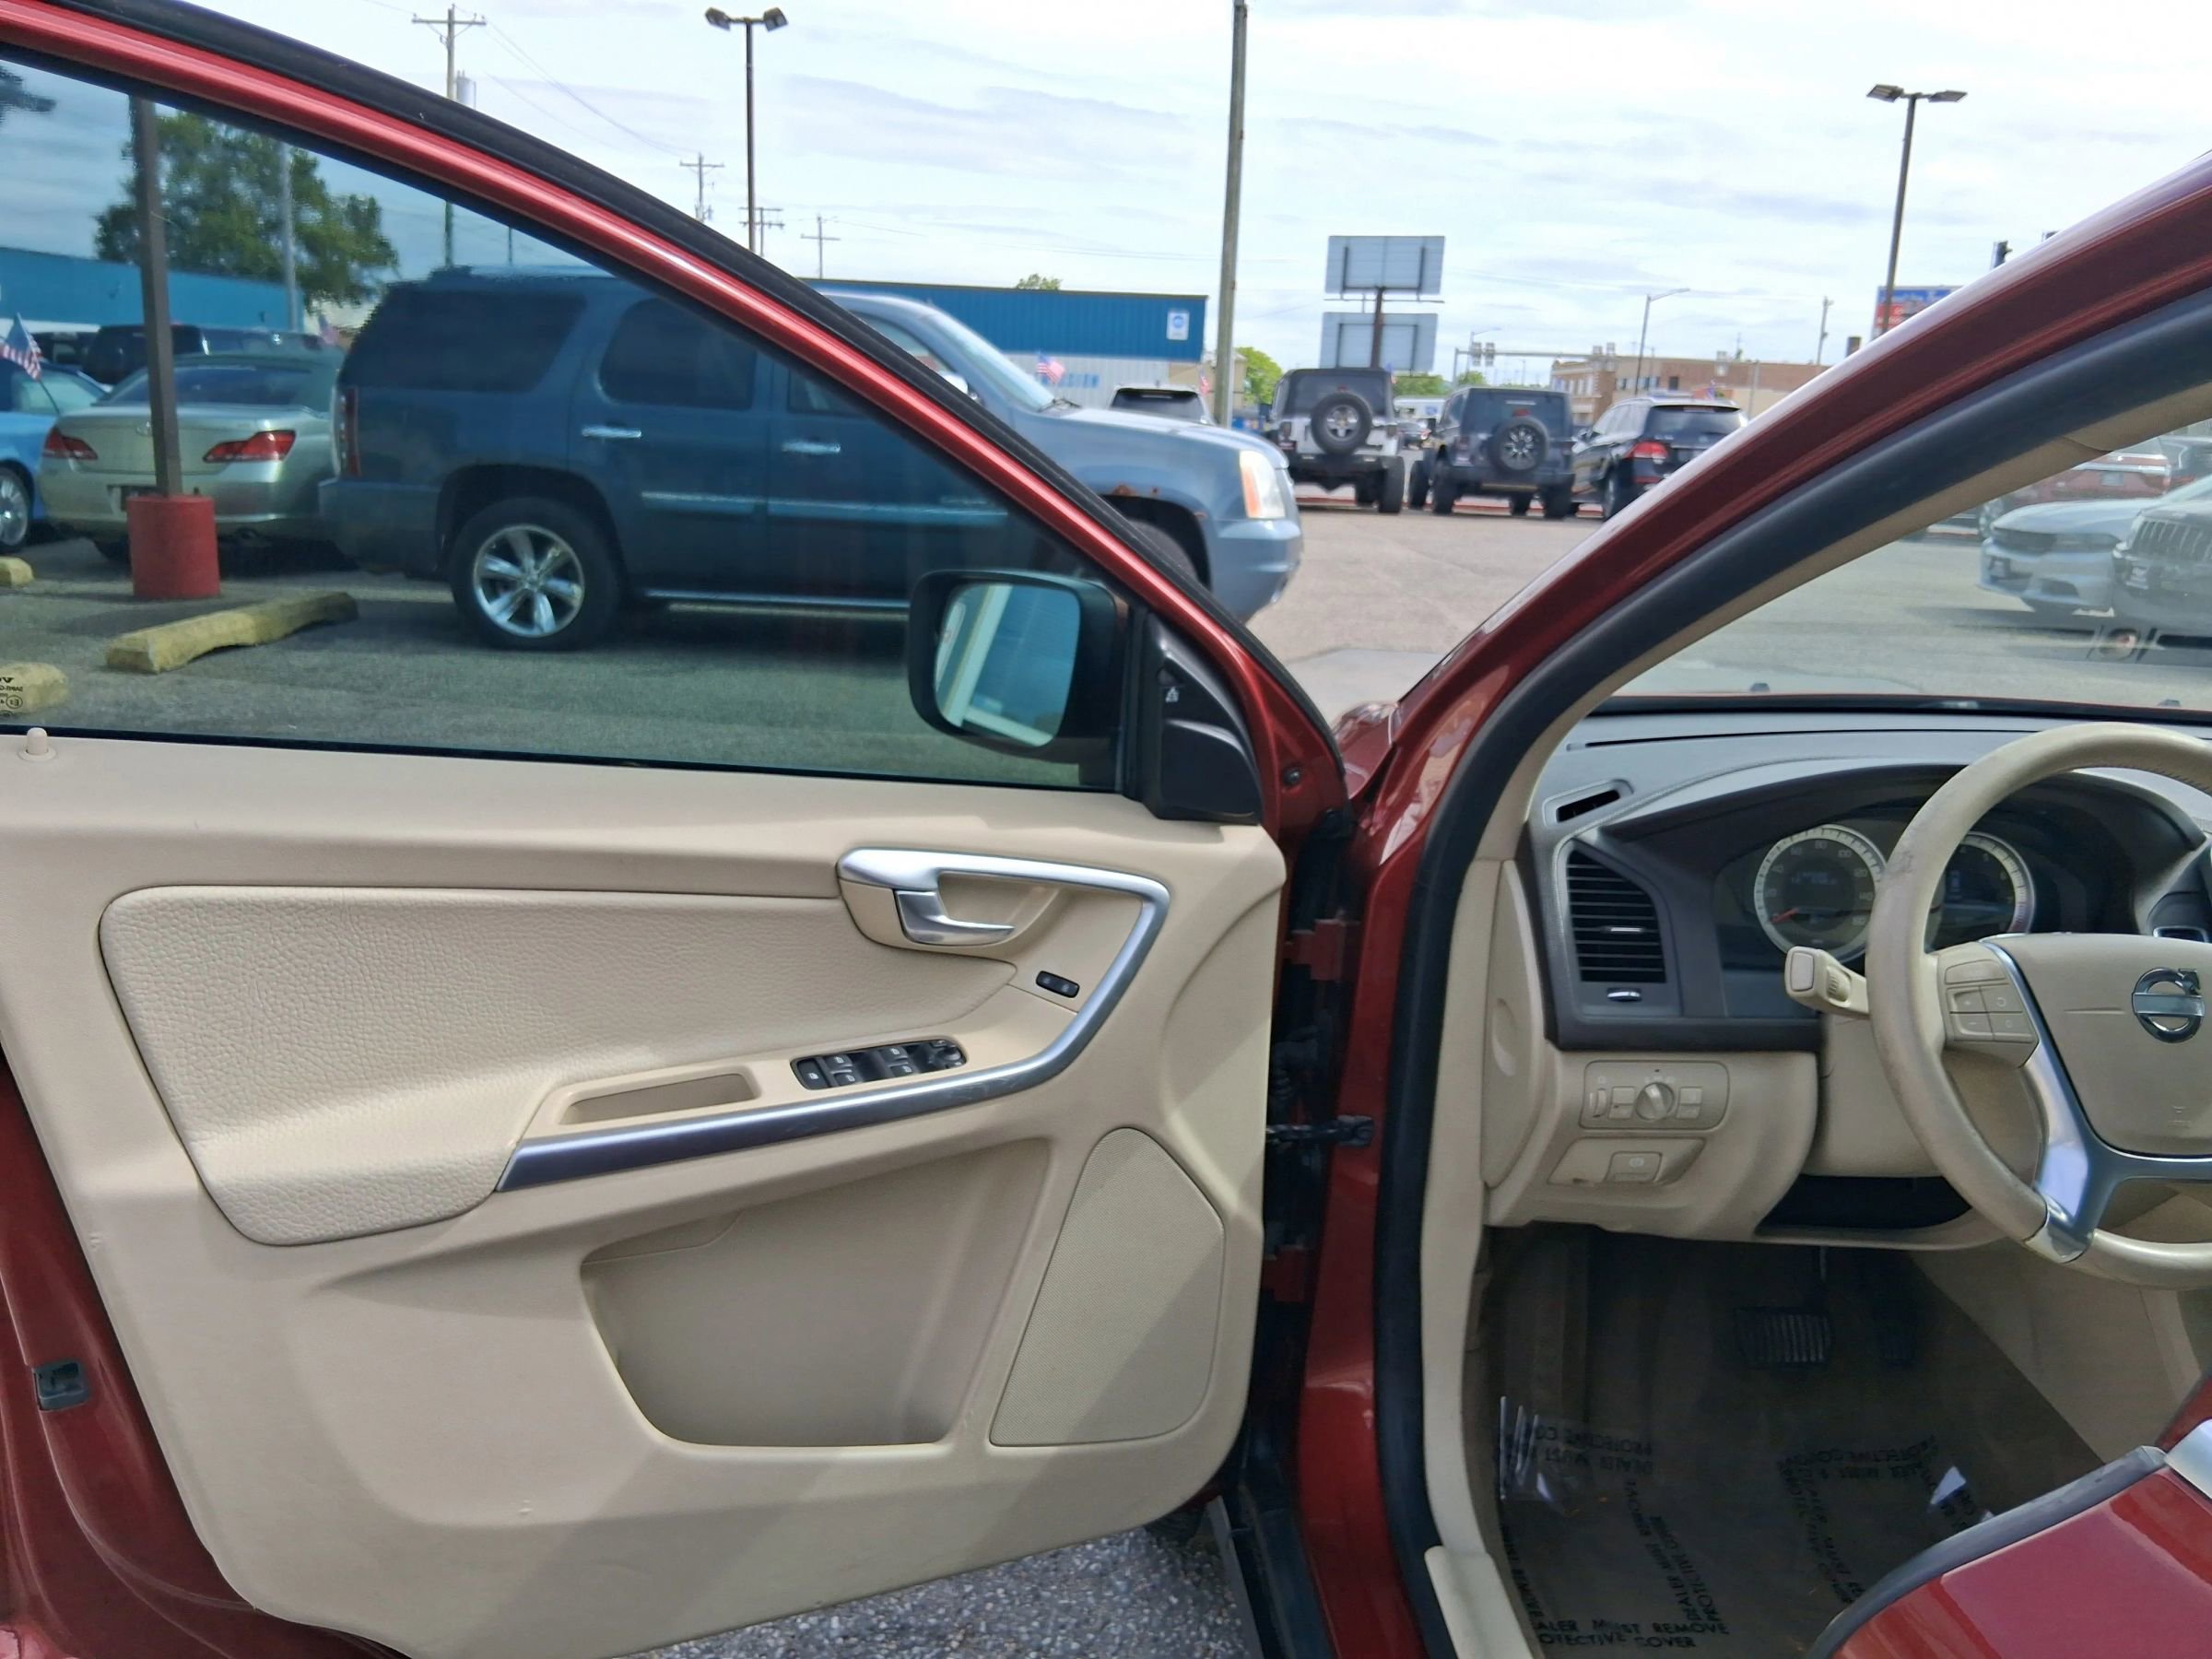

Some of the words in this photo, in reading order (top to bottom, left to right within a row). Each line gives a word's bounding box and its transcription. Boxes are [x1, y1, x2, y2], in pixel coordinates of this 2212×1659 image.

[1535, 1619, 1578, 1633] ALER
[1592, 1619, 1640, 1634] MUST
[1652, 1622, 1730, 1635] REMOVE
[1538, 1631, 1626, 1647] OTECTIVE
[1635, 1636, 1696, 1649] COVER
